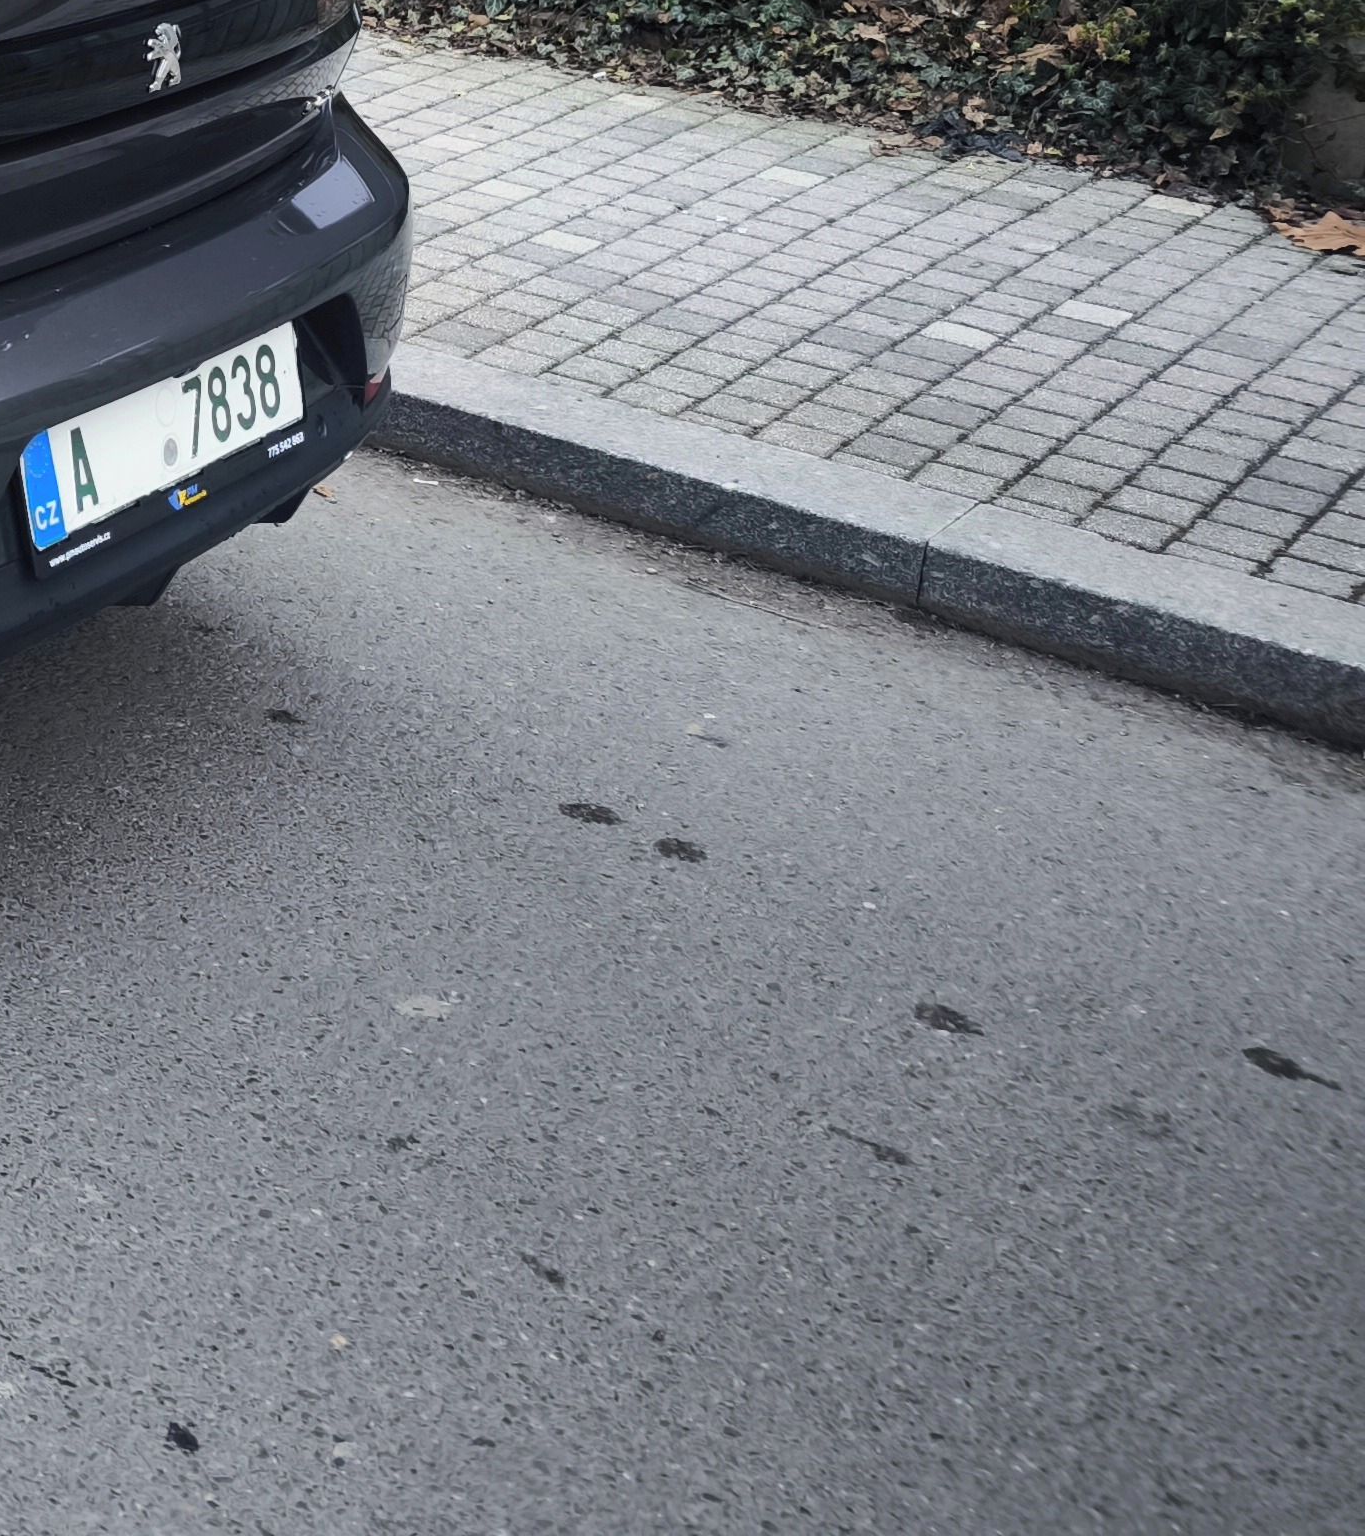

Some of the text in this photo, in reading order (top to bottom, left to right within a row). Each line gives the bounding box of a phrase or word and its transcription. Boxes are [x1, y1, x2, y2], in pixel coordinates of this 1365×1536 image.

[69, 343, 282, 513] A 7838
[34, 498, 60, 532] CZ
